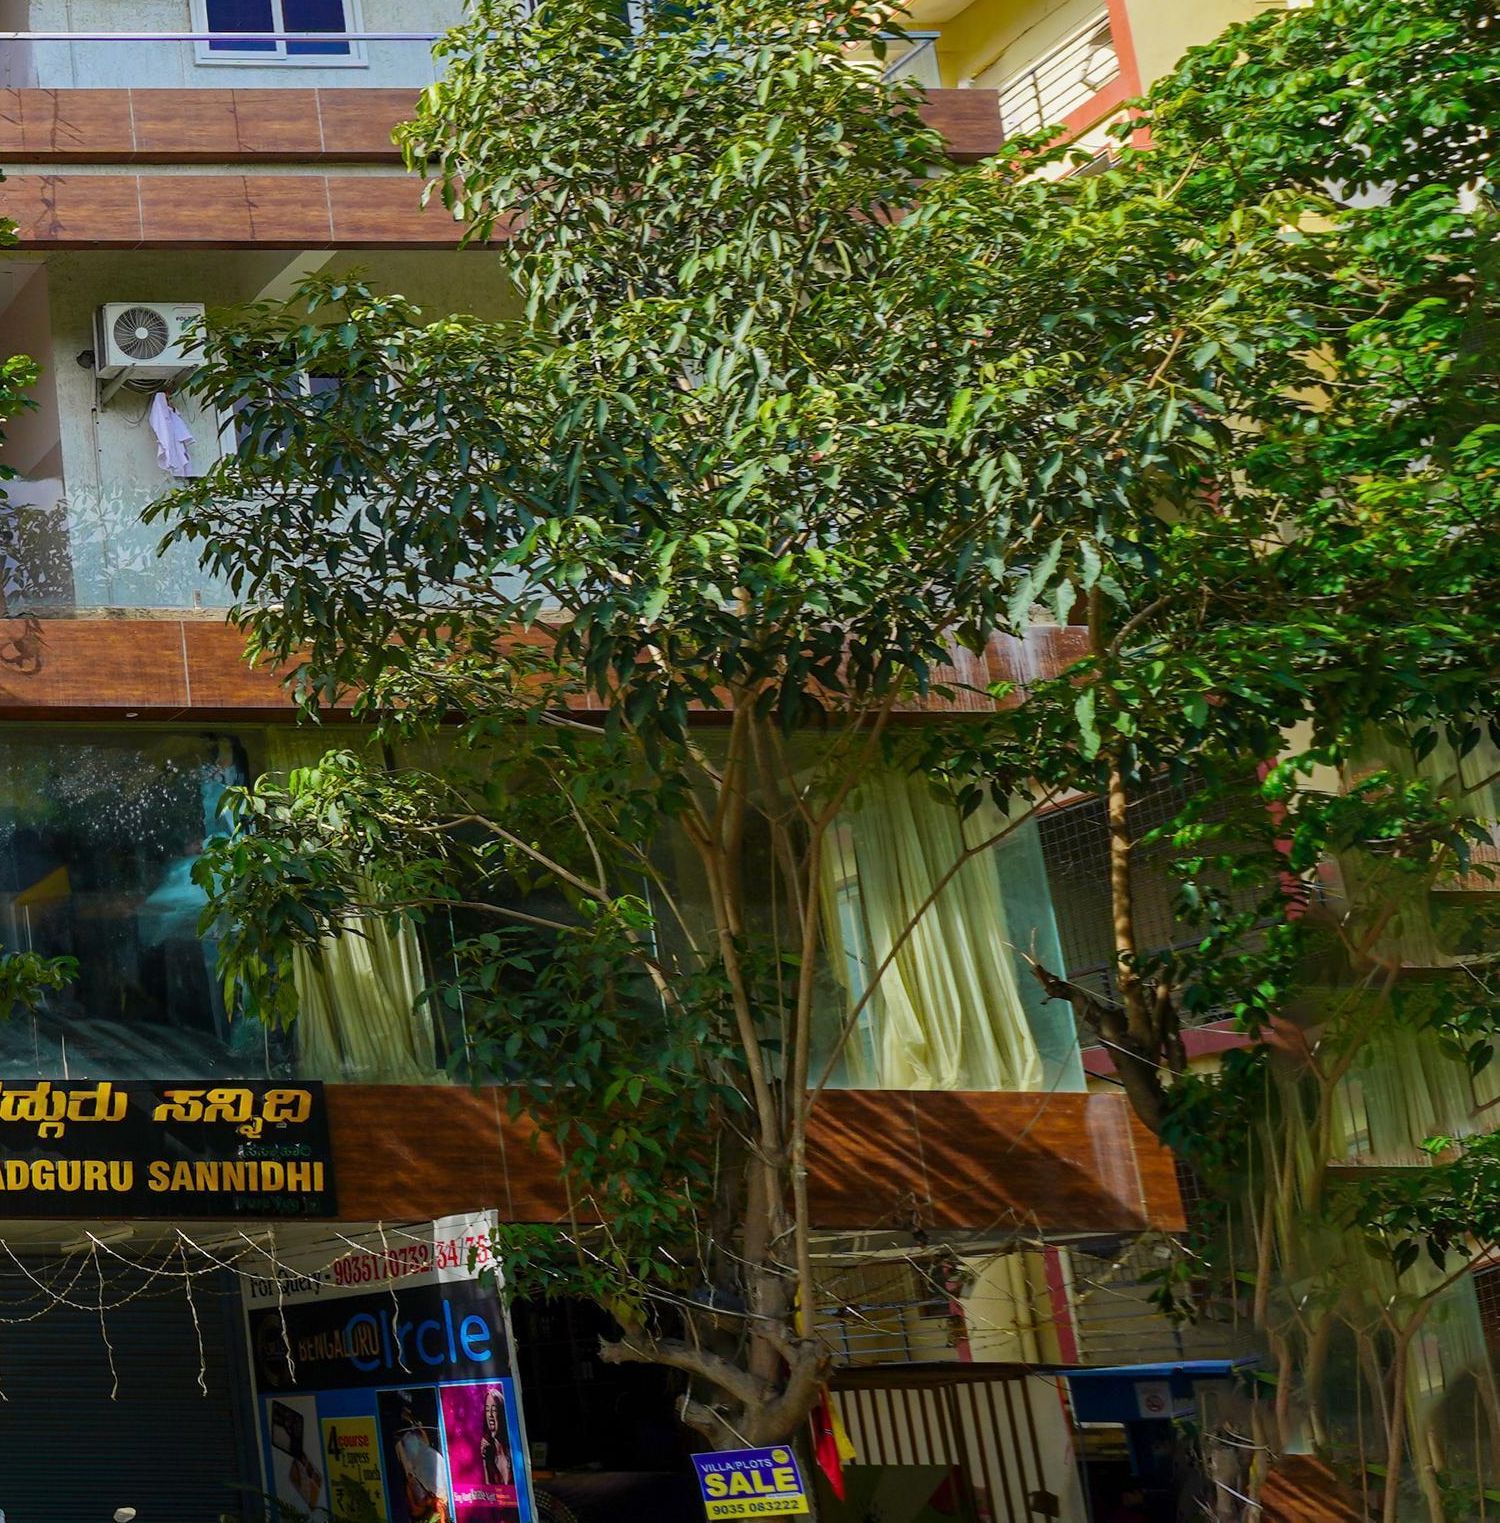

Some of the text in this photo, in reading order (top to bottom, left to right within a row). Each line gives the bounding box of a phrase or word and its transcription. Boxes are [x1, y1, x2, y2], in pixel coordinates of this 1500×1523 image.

[147, 1161, 324, 1193] SANNIDHI
[705, 1467, 799, 1497] SALE
[712, 1504, 745, 1515] 9035
